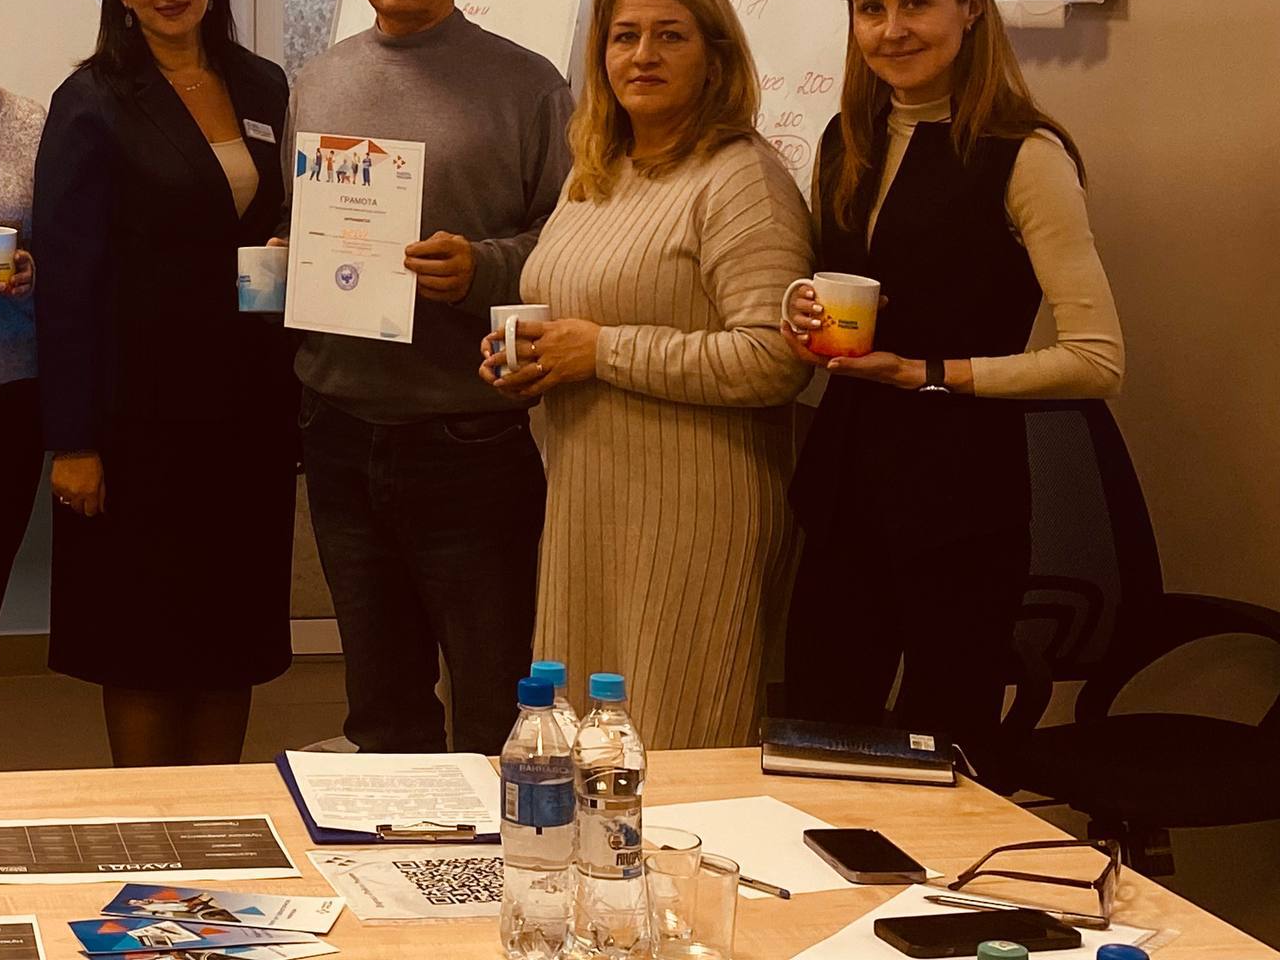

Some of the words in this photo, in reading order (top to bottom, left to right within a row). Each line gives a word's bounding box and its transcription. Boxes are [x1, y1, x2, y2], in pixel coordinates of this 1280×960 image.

[796, 71, 834, 95] 200
[339, 195, 378, 207] ГРАМОТА
[108, 863, 182, 871] РАУНД
